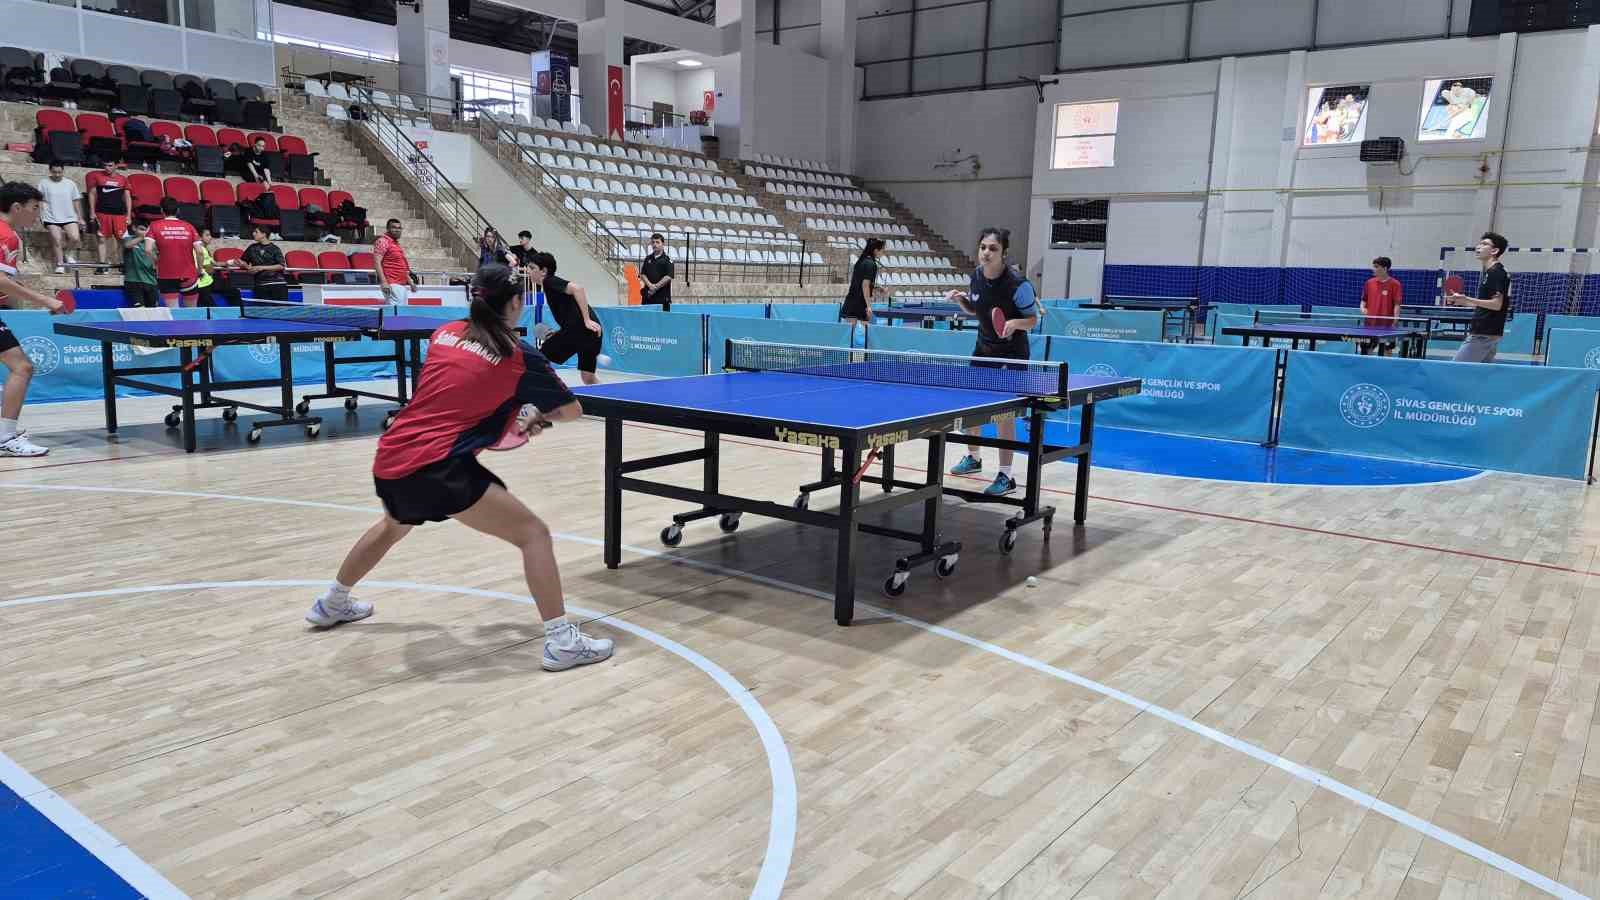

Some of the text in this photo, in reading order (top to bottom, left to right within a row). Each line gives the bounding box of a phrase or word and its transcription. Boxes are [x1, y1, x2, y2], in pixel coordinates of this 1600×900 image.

[63, 342, 131, 354] SİVAS GELİK
[1149, 377, 1182, 389] GENÇLİK
[1195, 381, 1221, 392] SPOR
[1395, 396, 1524, 418] SİVAS GENÇLİK VE SPOR
[1393, 409, 1477, 426] İL MÜDÜRLÜĞÜ
